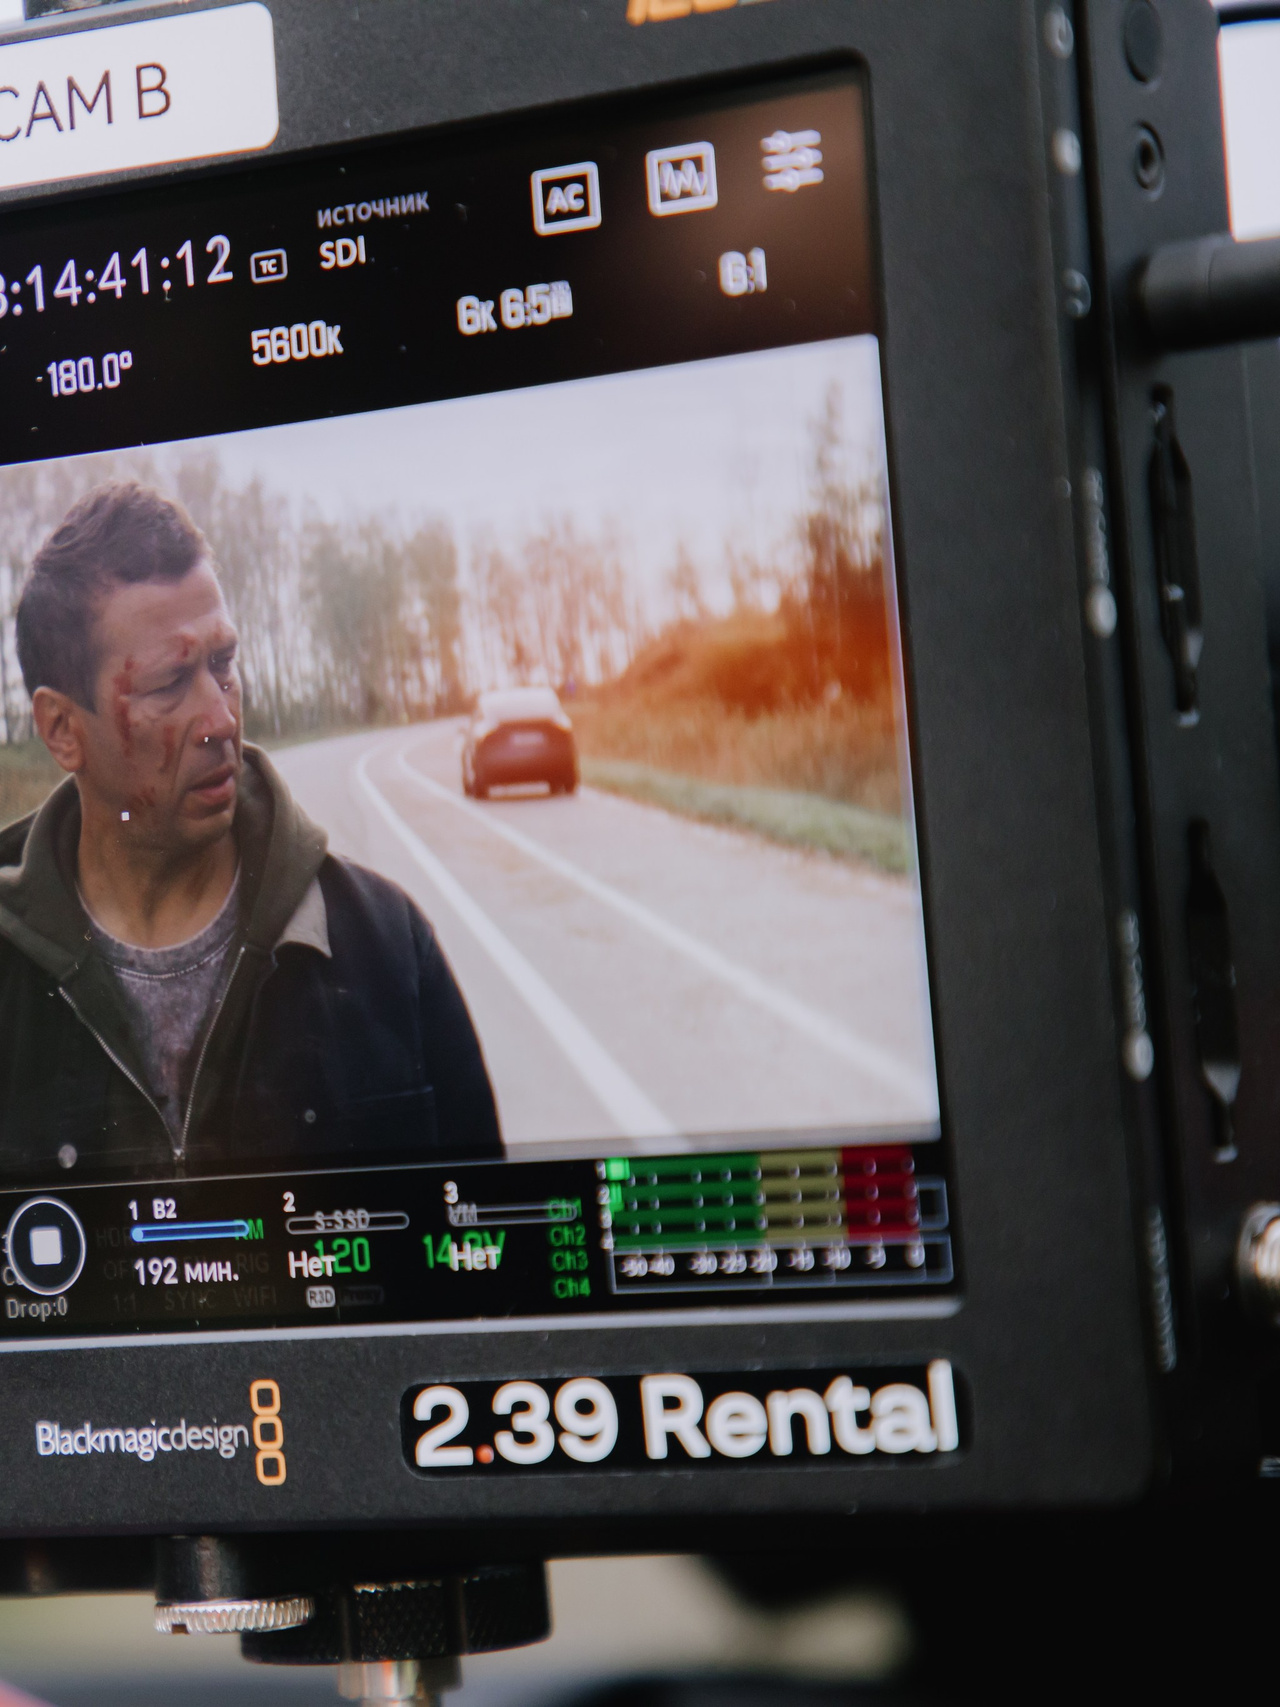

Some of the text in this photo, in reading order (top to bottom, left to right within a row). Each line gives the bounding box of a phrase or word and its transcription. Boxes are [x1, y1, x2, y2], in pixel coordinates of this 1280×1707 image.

[135, 62, 172, 120] B
[317, 191, 430, 229] ИСТОЧНИК
[545, 182, 585, 215] AC
[259, 258, 278, 275] TC
[319, 235, 366, 270] SDI
[282, 1191, 297, 1213] 2
[443, 1180, 460, 1205] 3
[128, 1197, 178, 1221] 1 B2
[548, 1224, 587, 1247] Ch2
[288, 1250, 337, 1279] Нет
[450, 1241, 502, 1272] Нет
[551, 1250, 589, 1272] Ch3
[133, 1256, 240, 1286] 192 мин.
[307, 1289, 336, 1306] R3D
[553, 1276, 591, 1299] Ch4
[6, 1296, 69, 1323] Drop:0
[413, 1359, 960, 1468] 2.39 Rental
[35, 1417, 250, 1462] Blackmagicdesign
